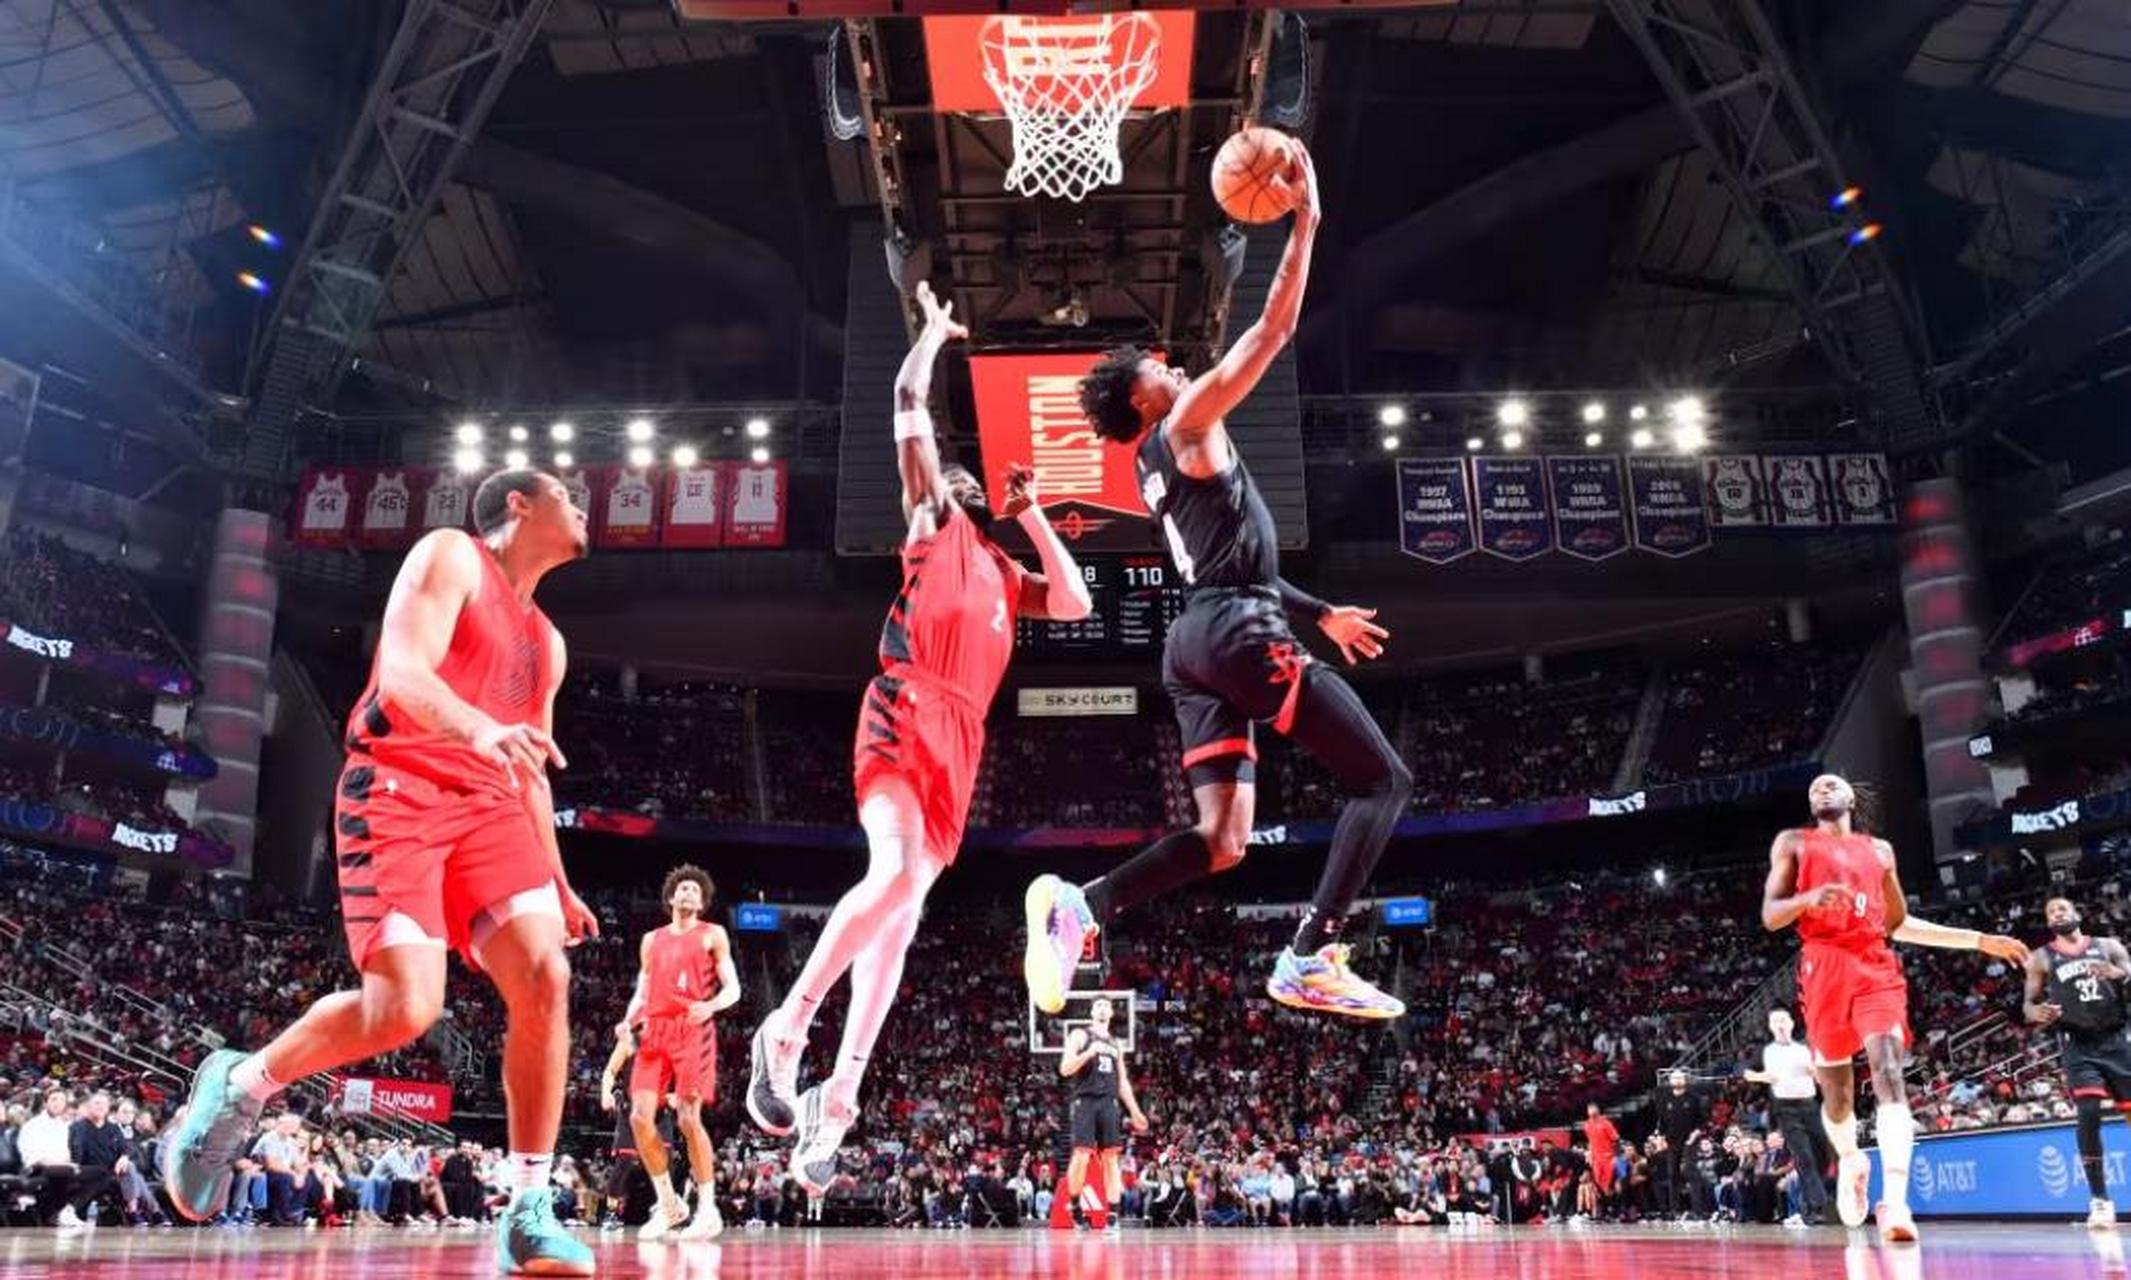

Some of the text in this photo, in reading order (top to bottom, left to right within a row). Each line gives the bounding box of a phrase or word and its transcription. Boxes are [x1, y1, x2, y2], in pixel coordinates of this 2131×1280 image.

[1027, 374, 1104, 495] HOUSTON
[1123, 567, 1162, 586] 110
[992, 598, 1004, 633] 2
[1854, 893, 1867, 918] 9
[2075, 978, 2104, 1002] 32
[376, 1090, 436, 1109] TUNDRA
[1937, 1161, 1977, 1192] AT&T
